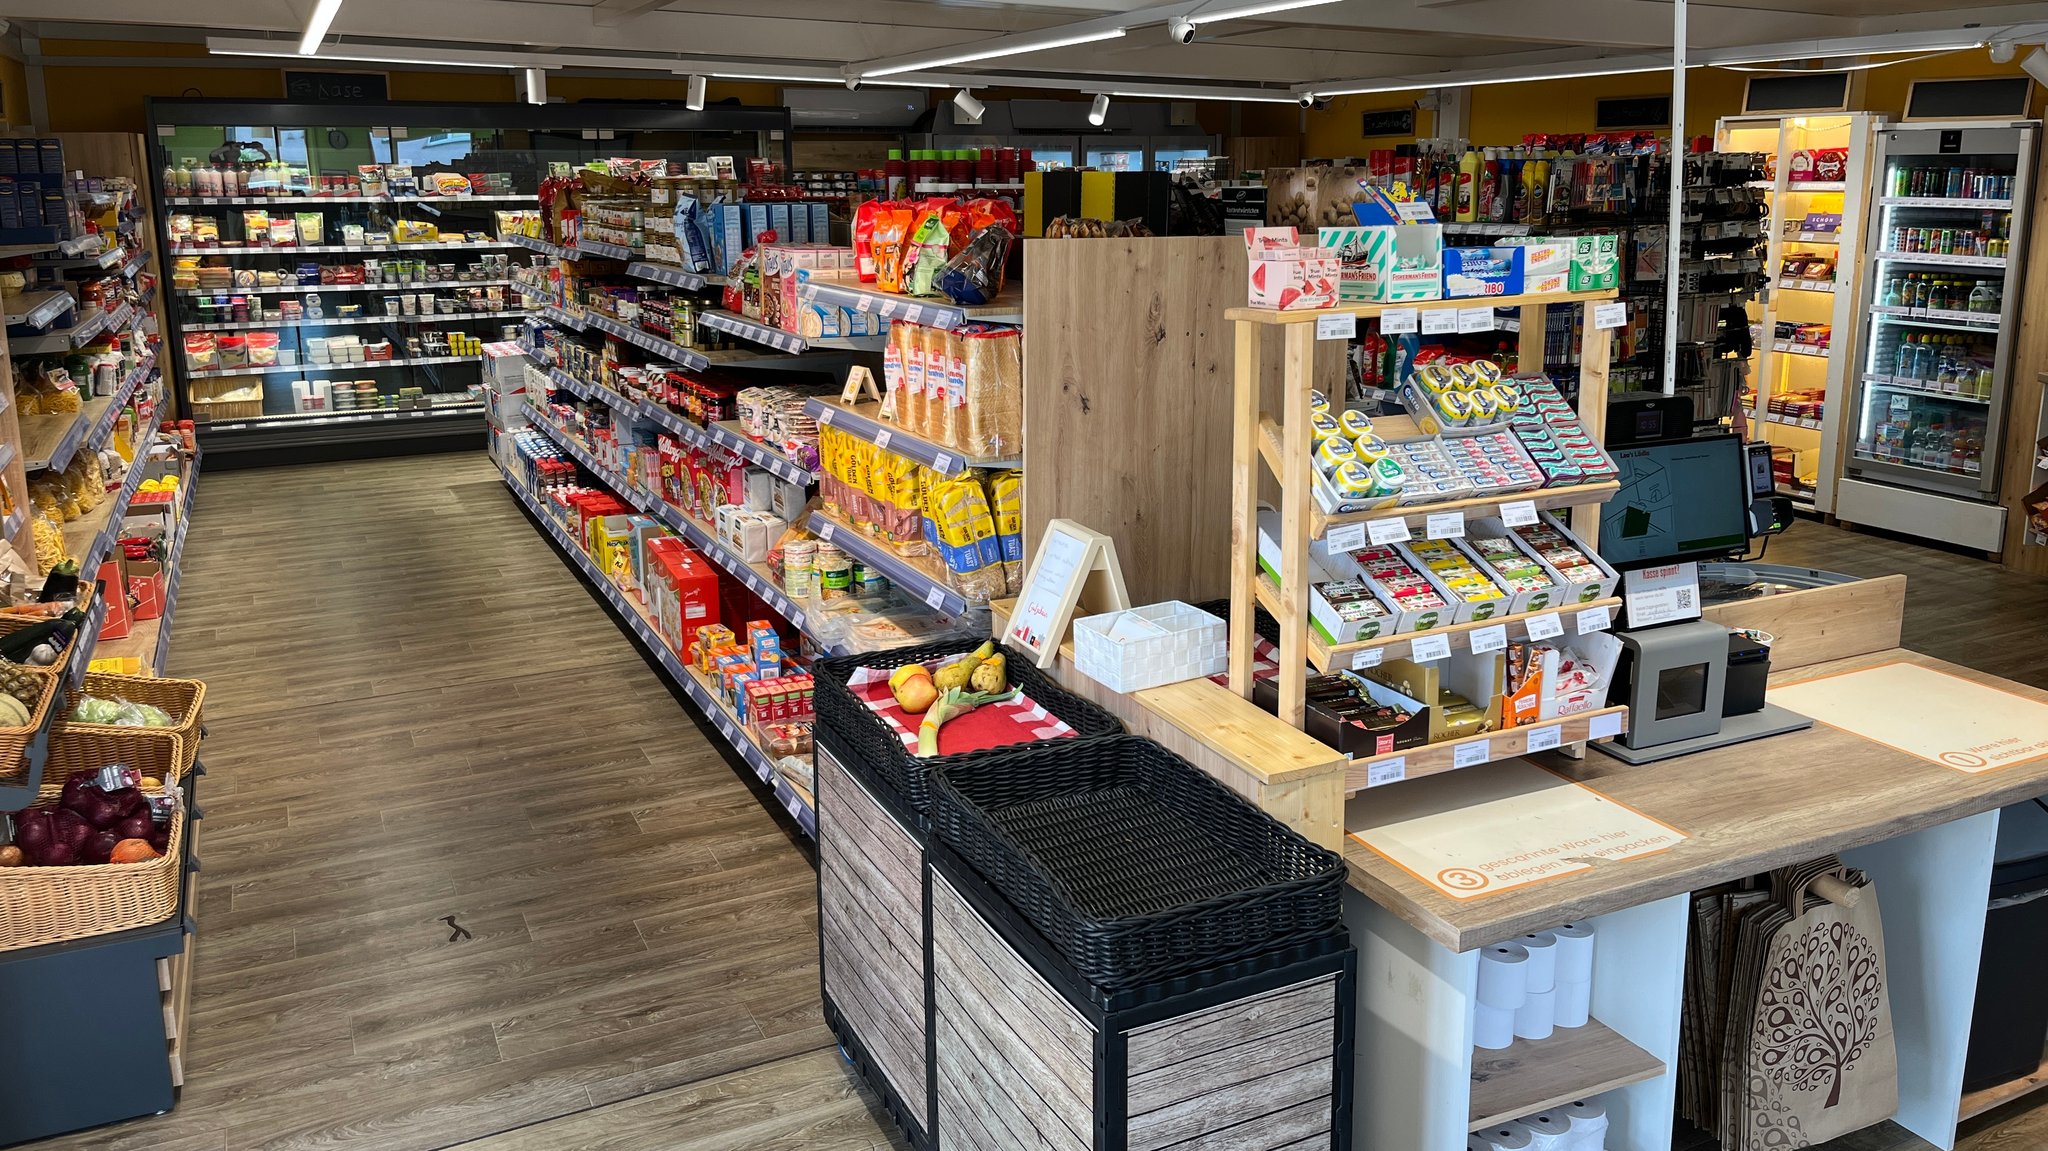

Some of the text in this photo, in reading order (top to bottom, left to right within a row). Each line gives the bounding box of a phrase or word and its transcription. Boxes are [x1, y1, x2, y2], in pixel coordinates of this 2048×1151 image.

[1359, 271, 1377, 280] FRIEND
[1642, 564, 1680, 580] Kasse spinnt?
[1557, 701, 1593, 716] Raffaello
[1433, 730, 1460, 739] ROCHER
[1478, 829, 1629, 872] gescannte Ware hier
[1497, 861, 1562, 882] ablegen
[1593, 834, 1671, 858] einpacken
[1449, 872, 1477, 886] 3
